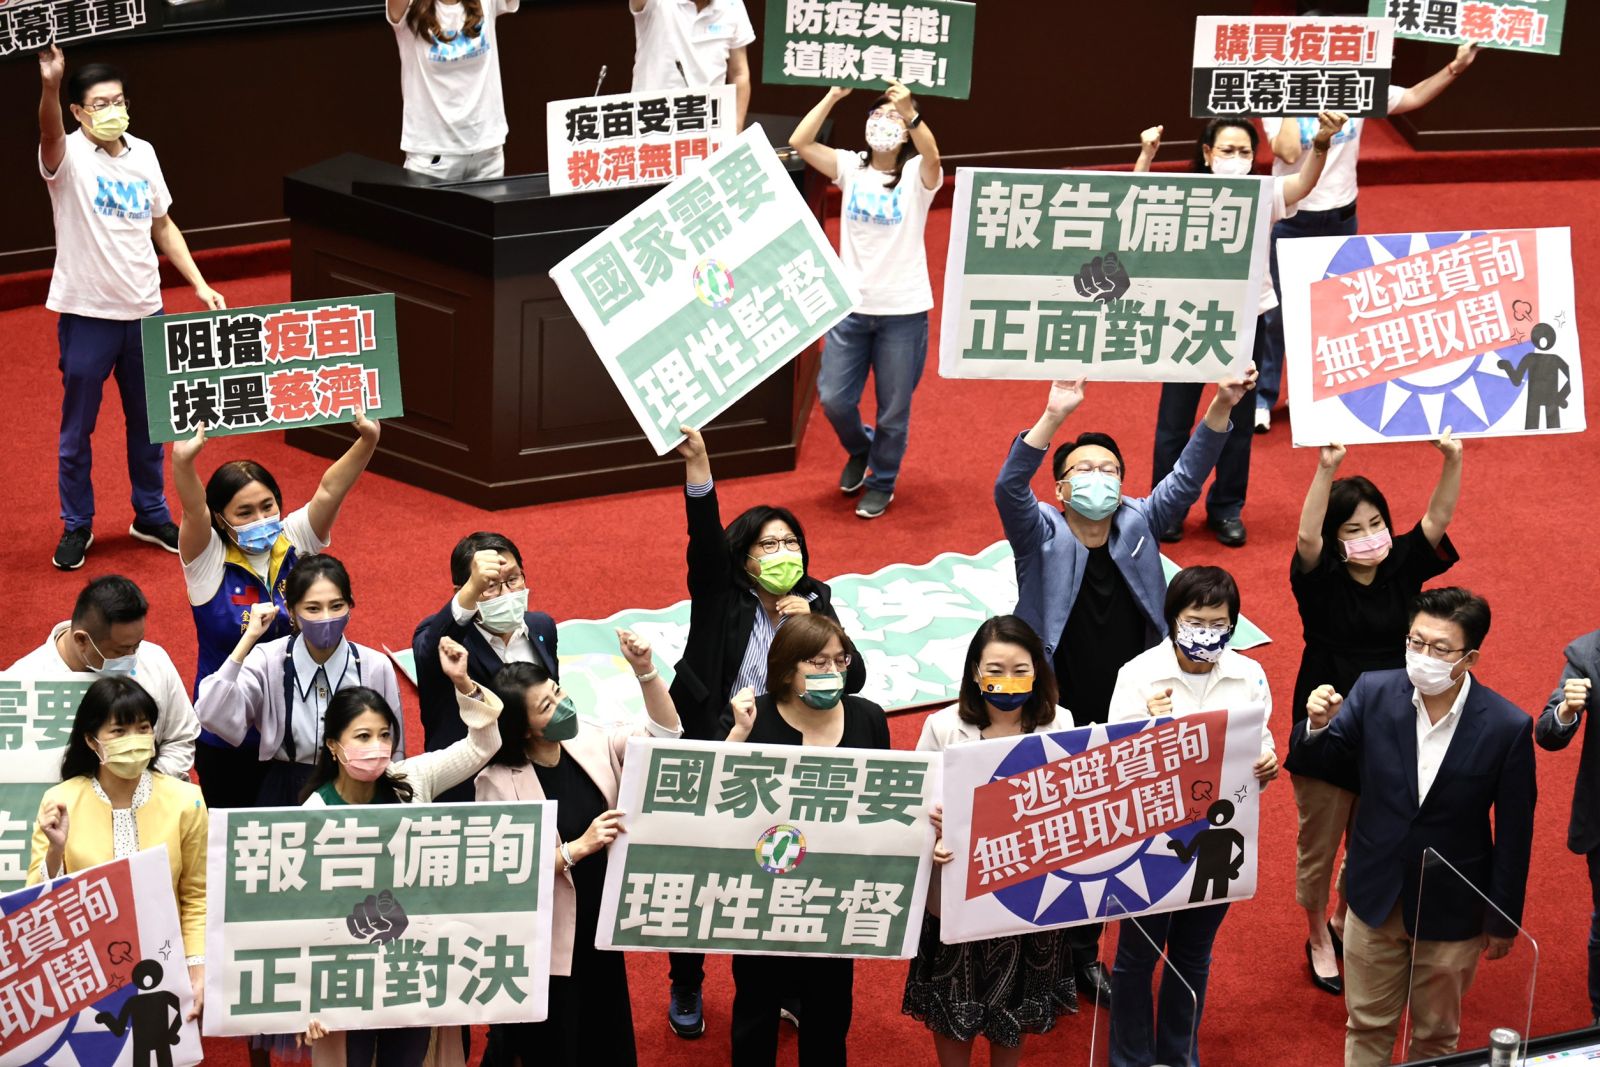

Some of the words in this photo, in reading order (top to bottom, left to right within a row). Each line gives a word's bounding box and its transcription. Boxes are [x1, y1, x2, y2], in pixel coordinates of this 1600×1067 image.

[785, 0, 951, 44] 防疫失能!
[1213, 23, 1378, 64] 購買疫苗!
[1388, 0, 1548, 46] 抹黑慈濟!
[782, 40, 948, 87] 道歉負責!
[1207, 69, 1375, 113] 黑幕重重!
[565, 94, 719, 142] 疫苗受害!
[567, 137, 719, 188] 救濟無門
[570, 141, 776, 327] 國家需要
[975, 181, 1254, 255] 報告備詢
[1340, 236, 1526, 324] 逃避質詢
[165, 306, 375, 374] 阻擋疫苗!
[634, 249, 838, 431] 理性監督
[962, 298, 1237, 368] 正面對決
[1315, 290, 1511, 388] 無理取鬧
[170, 363, 381, 434] 抹黑慈濟!
[641, 747, 929, 826] 國家需要
[1008, 721, 1210, 823] 逃避質詢
[232, 813, 536, 895] 報告備詢
[973, 774, 1186, 886] 無理取鬧
[620, 872, 904, 948] 理性監督
[230, 934, 531, 1017] 正面對決
